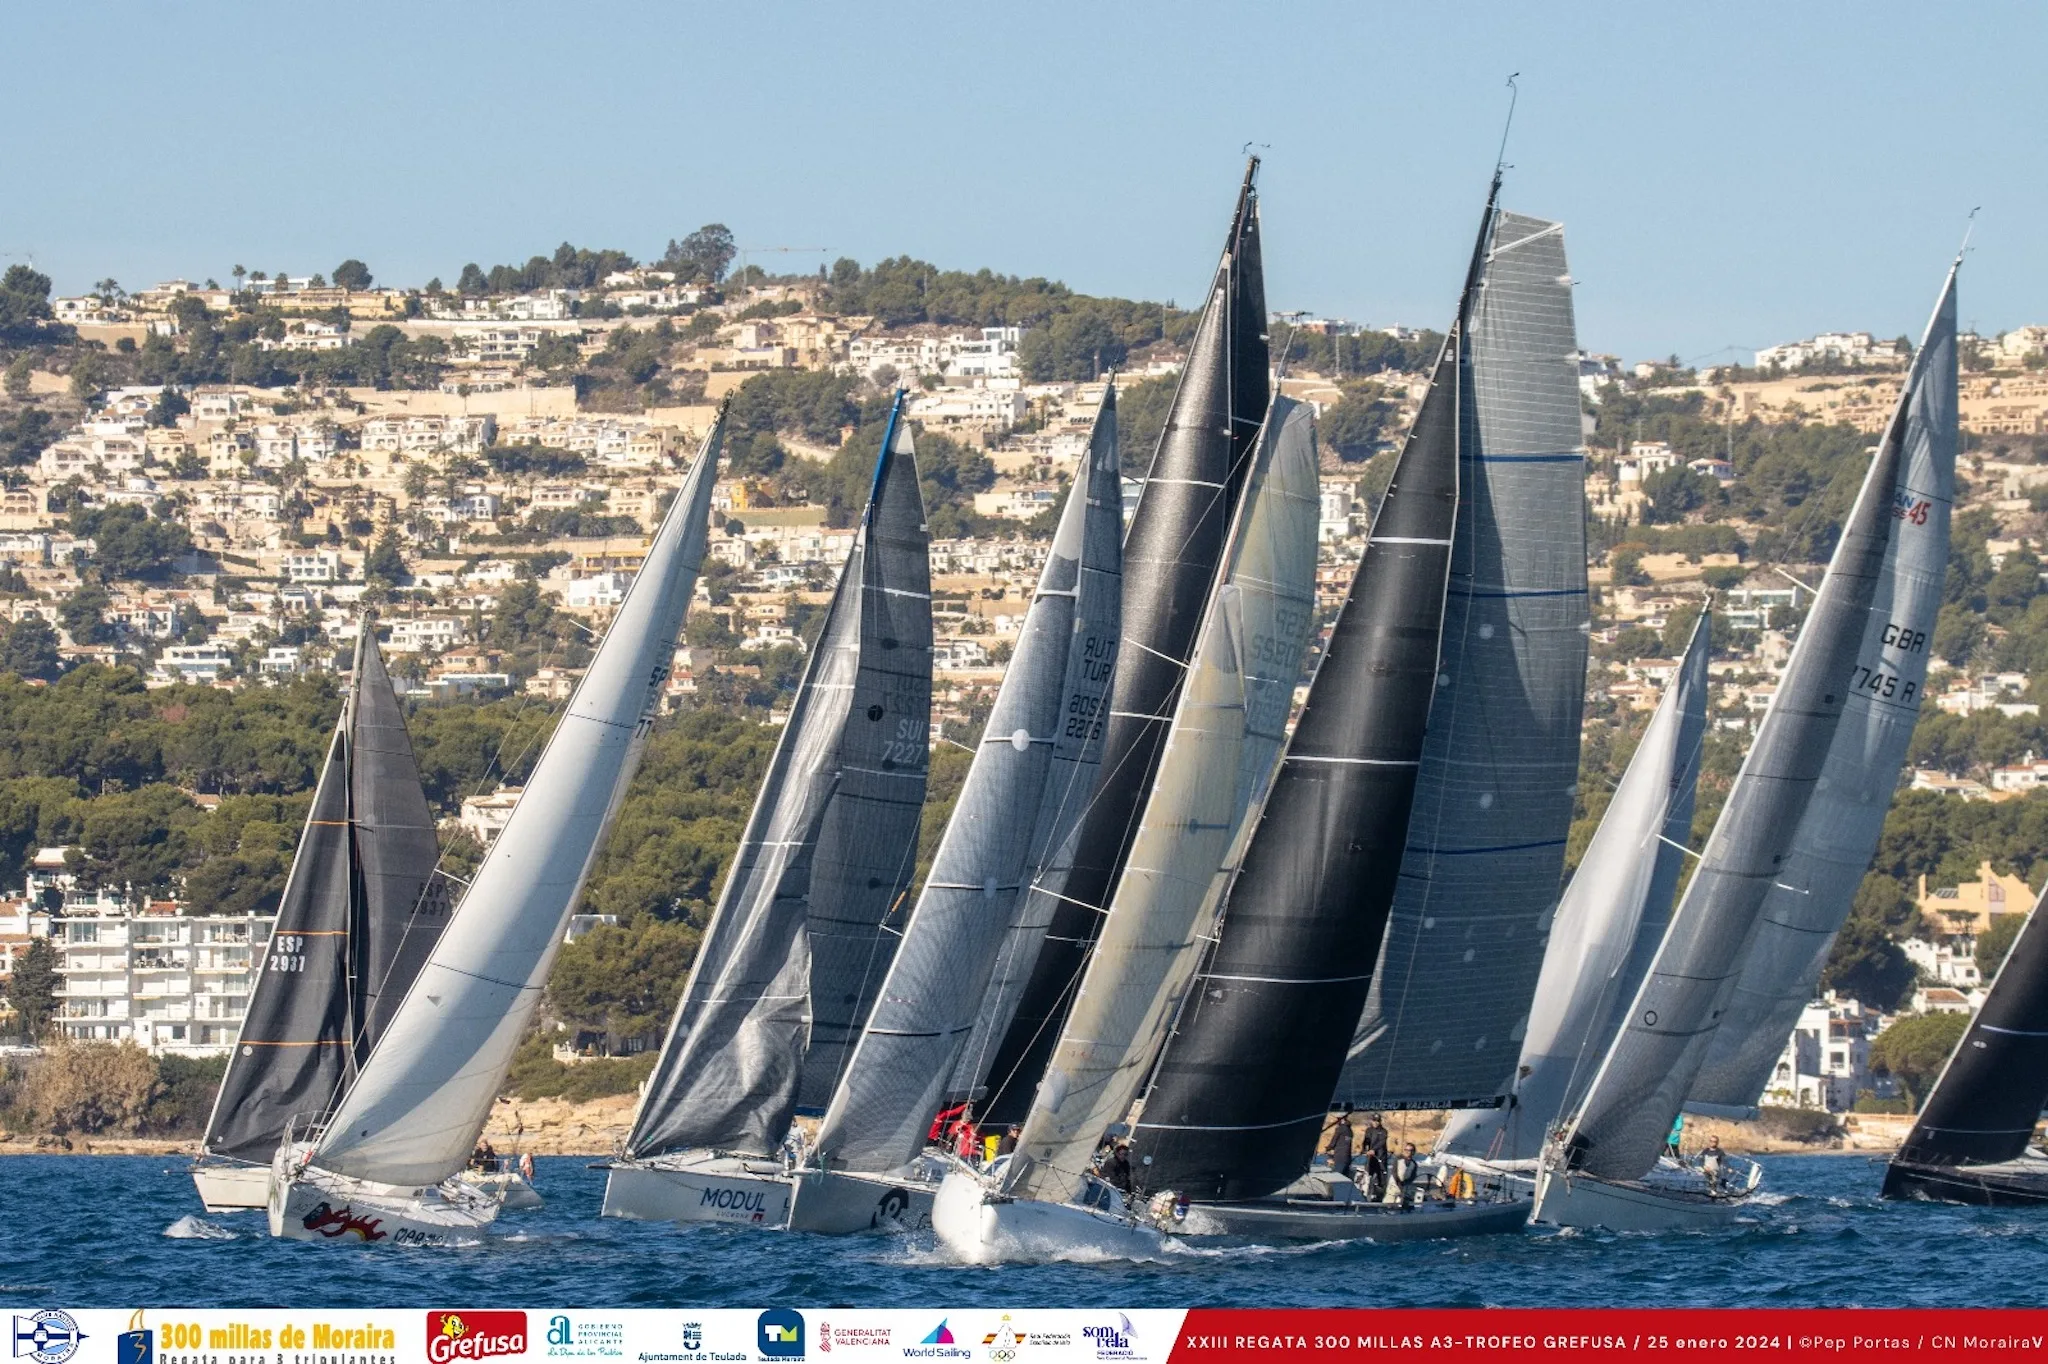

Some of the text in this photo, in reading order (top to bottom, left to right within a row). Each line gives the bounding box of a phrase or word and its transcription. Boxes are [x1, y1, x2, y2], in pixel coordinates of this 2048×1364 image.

[1909, 501, 1932, 525] 45
[1881, 623, 1926, 653] GBR
[1083, 659, 1111, 682] TUR
[1901, 681, 1917, 703] R
[896, 718, 924, 741] SUI
[1065, 718, 1103, 740] 2206
[881, 740, 925, 764] 7227
[277, 935, 303, 953] ESP
[270, 955, 305, 972] 2937
[1405, 1100, 1452, 1109] VALENCIA
[700, 1187, 766, 1213] MODUL
